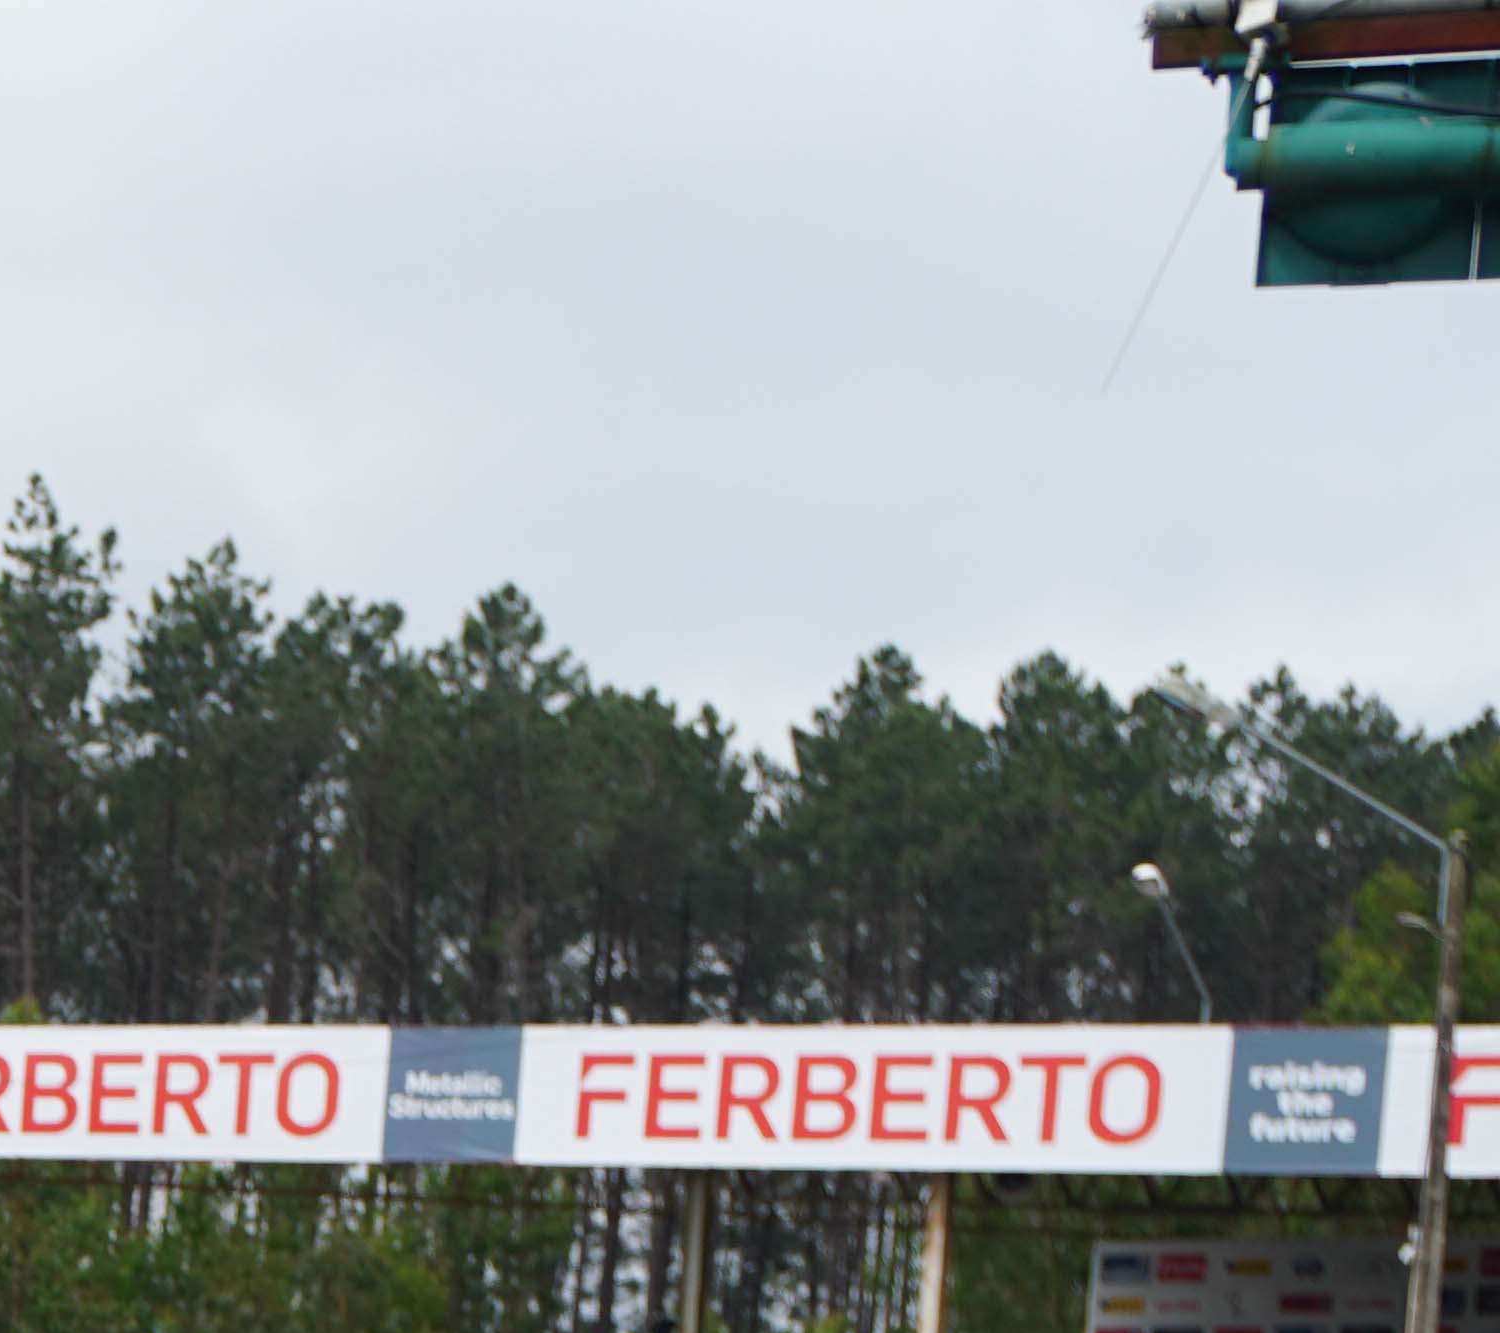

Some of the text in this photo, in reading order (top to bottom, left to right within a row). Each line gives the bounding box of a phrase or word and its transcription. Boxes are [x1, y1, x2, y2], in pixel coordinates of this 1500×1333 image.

[405, 1068, 502, 1096] Metallic
[1250, 1063, 1365, 1099] raising
[389, 1092, 515, 1124] Structures
[574, 1052, 1163, 1146] FERBERTO
[1278, 1090, 1334, 1119] the
[1251, 1117, 1354, 1144] future
